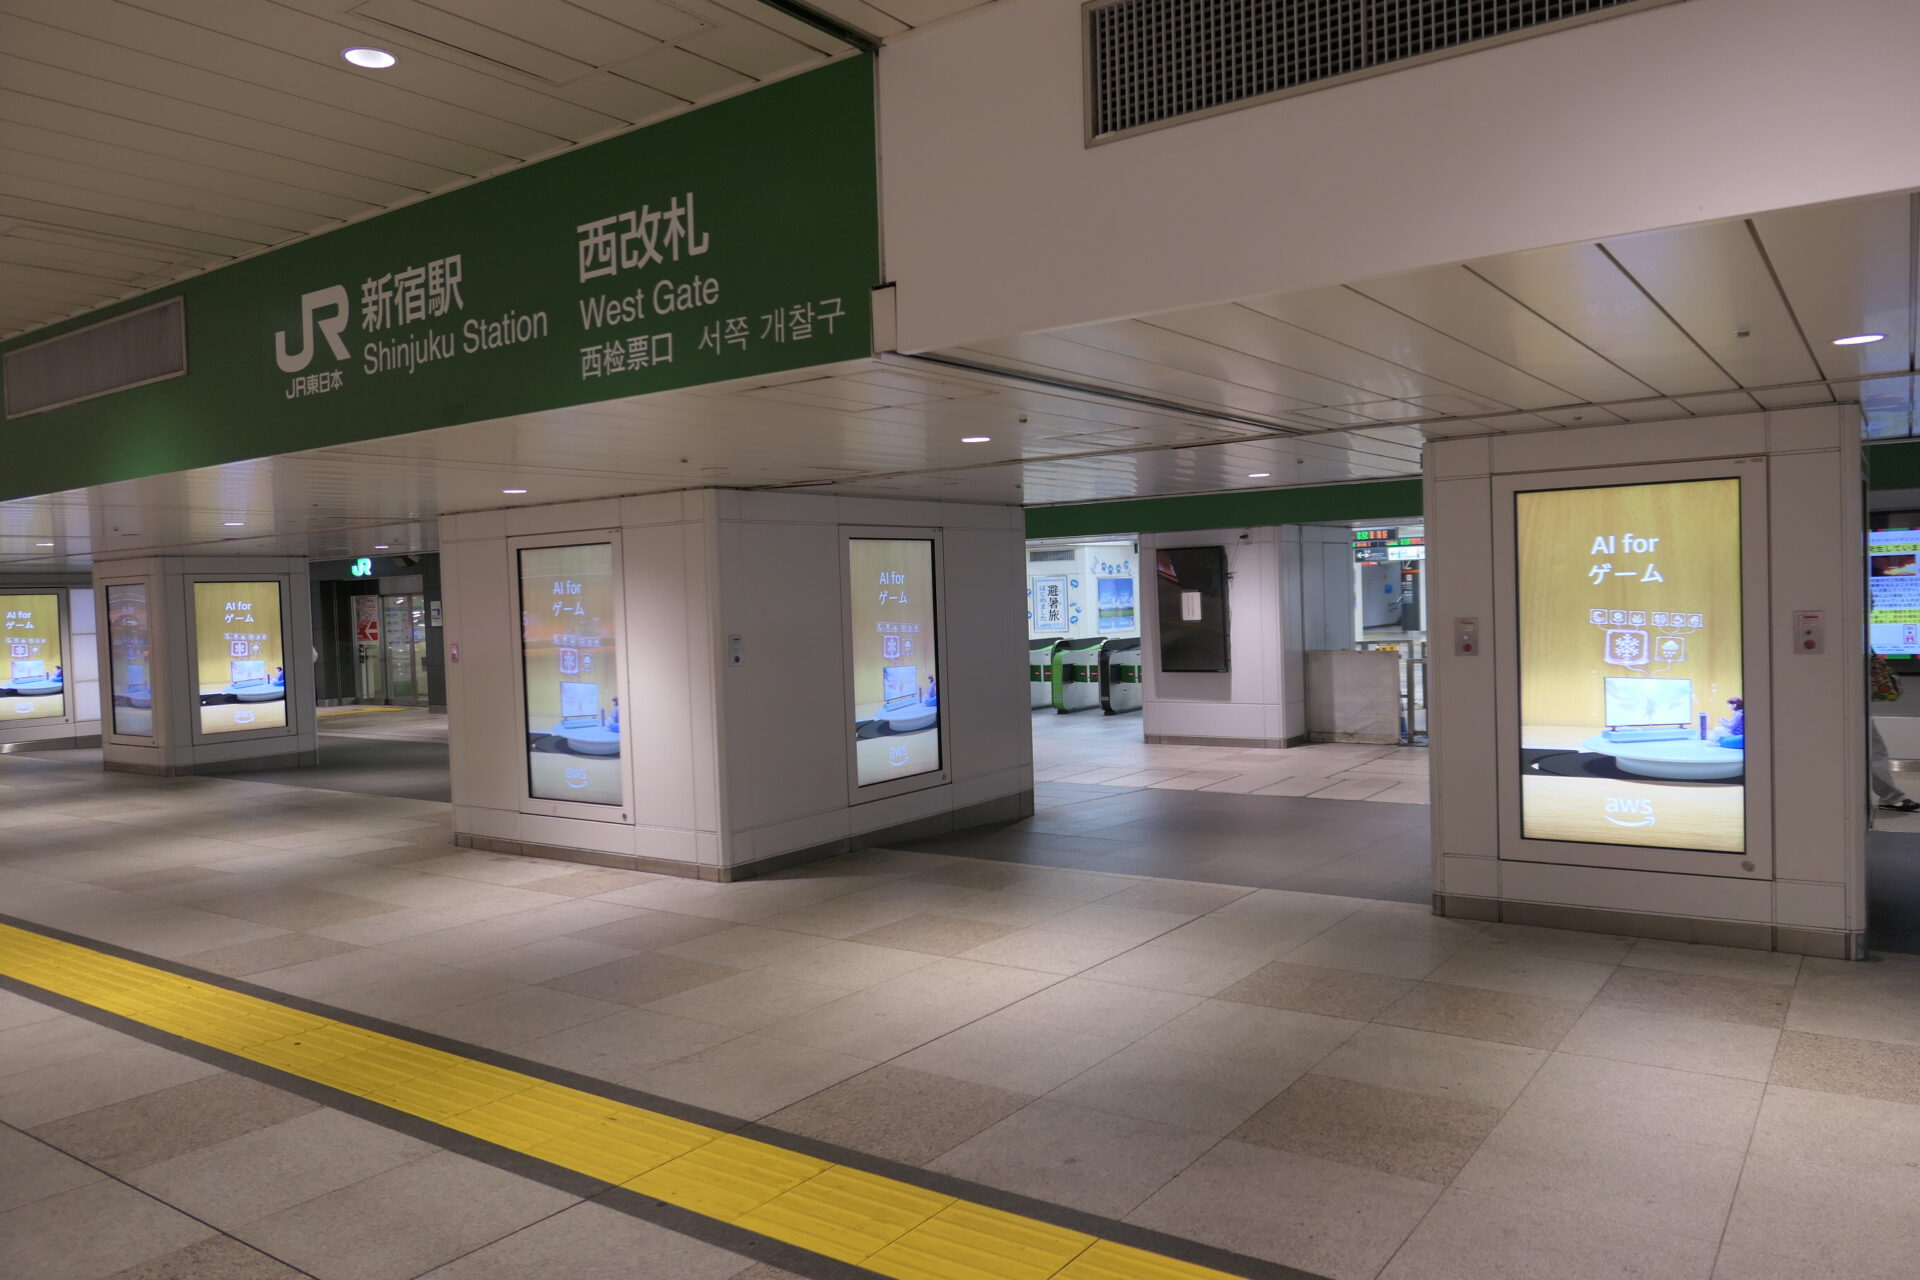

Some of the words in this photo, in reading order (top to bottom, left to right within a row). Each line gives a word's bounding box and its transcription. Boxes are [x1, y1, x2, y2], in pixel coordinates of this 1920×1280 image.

[577, 192, 709, 283] 西改札
[361, 254, 464, 333] 新宿駅
[580, 288, 645, 330] West
[653, 274, 719, 316] Gate
[275, 284, 352, 374] JR
[698, 318, 749, 356] 서쪽
[760, 297, 846, 343] 개찰구
[363, 328, 455, 376] Shinjuku
[463, 305, 549, 354] Station
[580, 332, 674, 380] 西检票口
[285, 369, 344, 400] JR東日本
[1590, 534, 1618, 556] AI
[1621, 531, 1662, 555] for
[351, 557, 372, 577] JR
[880, 571, 889, 585] AI
[891, 570, 905, 585] for
[1587, 561, 1666, 586] ゲーム
[553, 581, 564, 595] AI
[566, 580, 583, 595] for
[878, 590, 908, 606] ゲーム
[18, 610, 33, 619] for
[225, 602, 236, 611] AI
[238, 601, 252, 611] for
[552, 600, 585, 617] ゲーム
[224, 613, 255, 624] ゲーム
[565, 767, 587, 780] aws
[1604, 797, 1654, 815] aws
